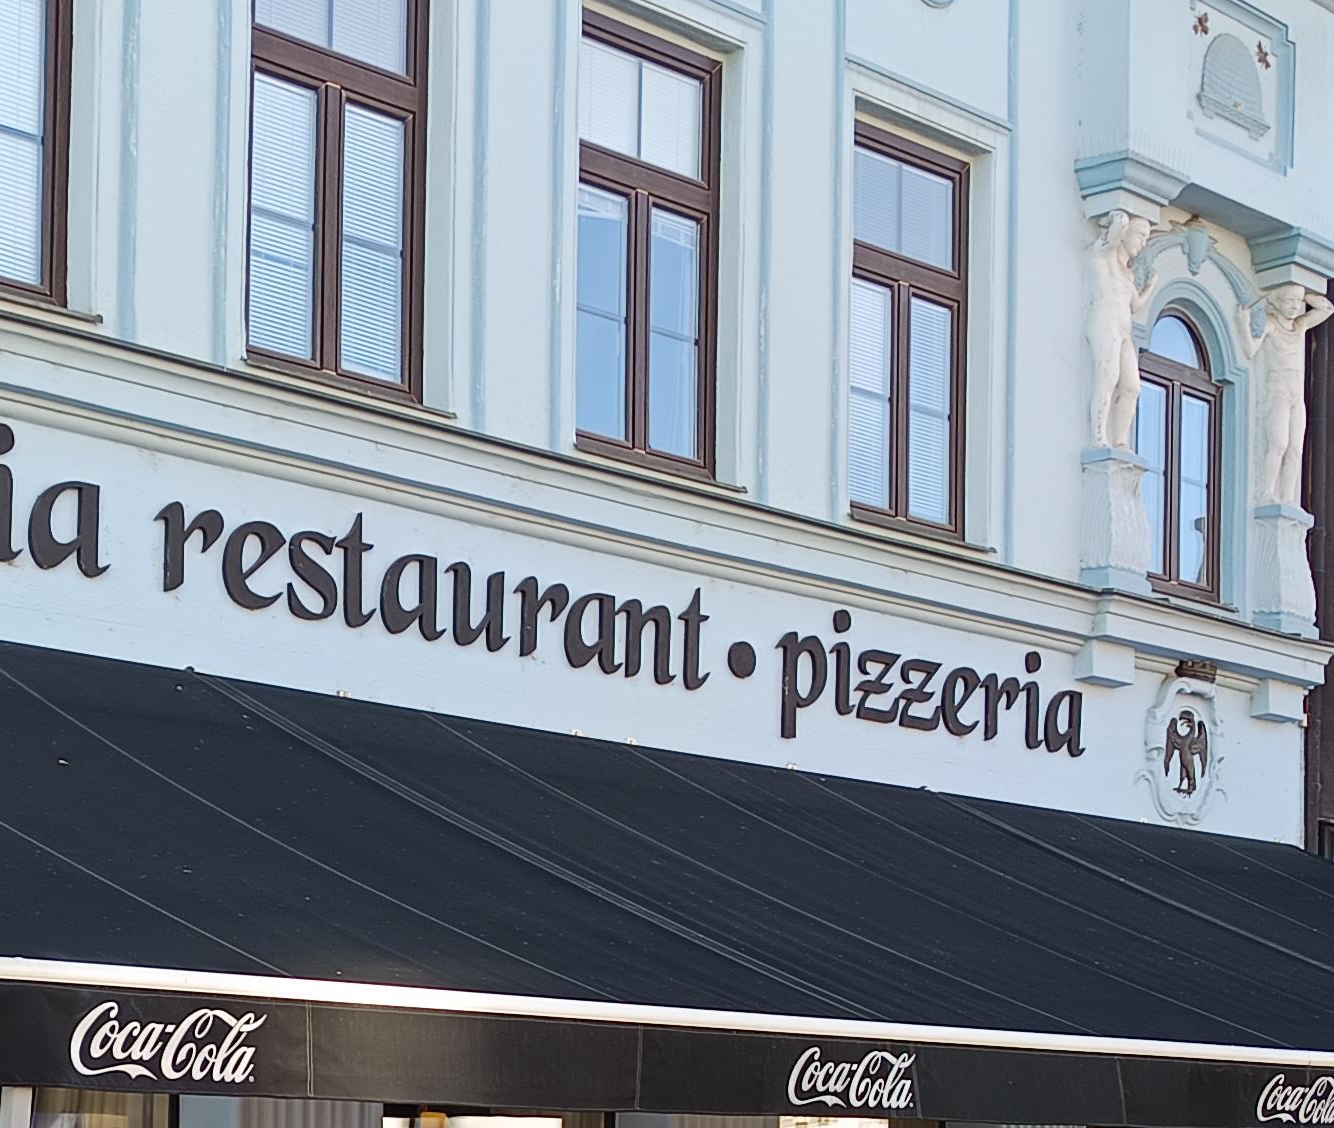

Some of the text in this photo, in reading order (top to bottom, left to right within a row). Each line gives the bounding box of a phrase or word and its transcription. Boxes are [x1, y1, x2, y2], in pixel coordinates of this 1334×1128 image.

[153, 501, 711, 690] restaurant
[775, 609, 1086, 758] pizzeria
[70, 1001, 267, 1083] Coca-Cola
[788, 1047, 916, 1109] Coca-Cola
